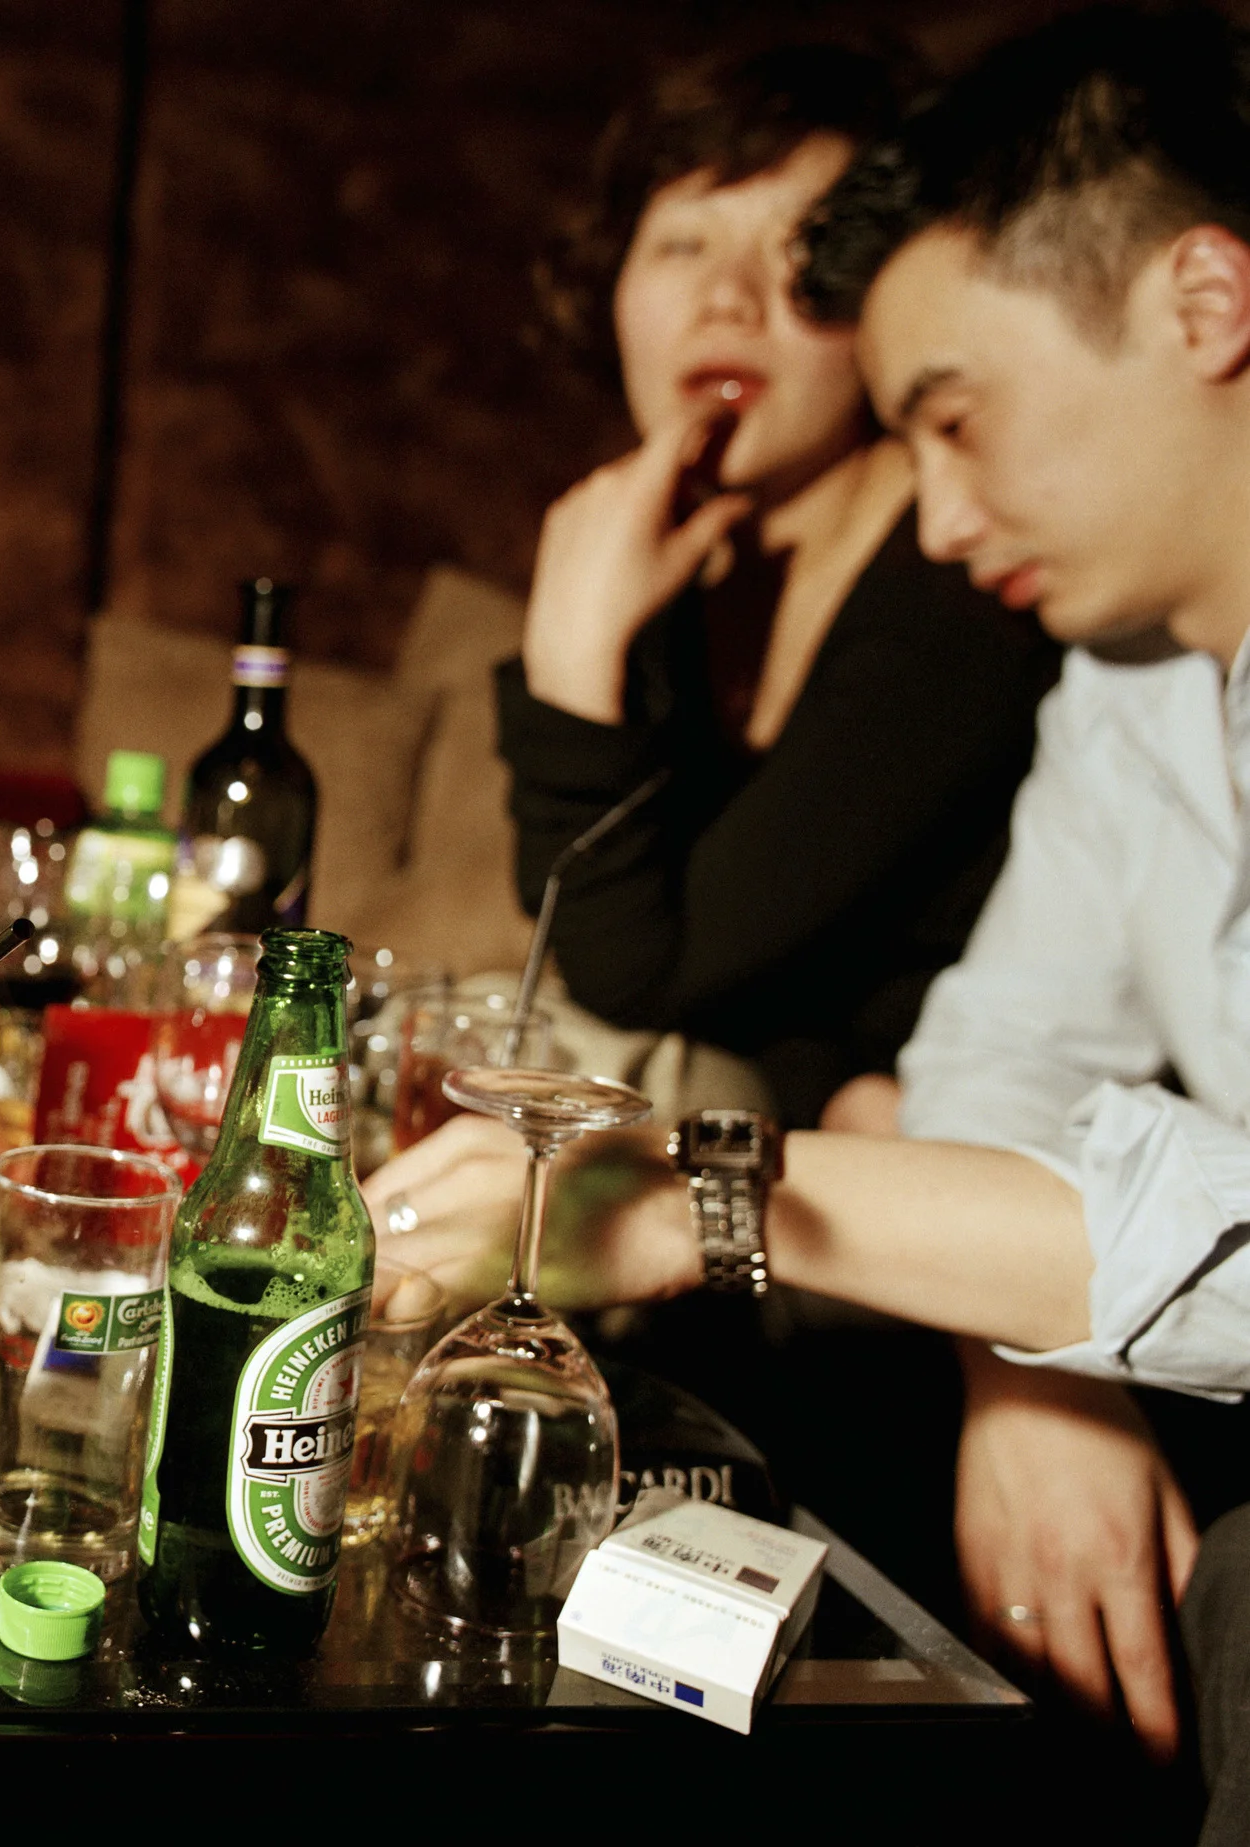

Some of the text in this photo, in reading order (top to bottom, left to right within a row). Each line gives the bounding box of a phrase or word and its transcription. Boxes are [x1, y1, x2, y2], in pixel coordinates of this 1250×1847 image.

[270, 1321, 348, 1401] HEINEKEN
[260, 1490, 281, 1499] EST.
[601, 1659, 670, 1694] 中南海
